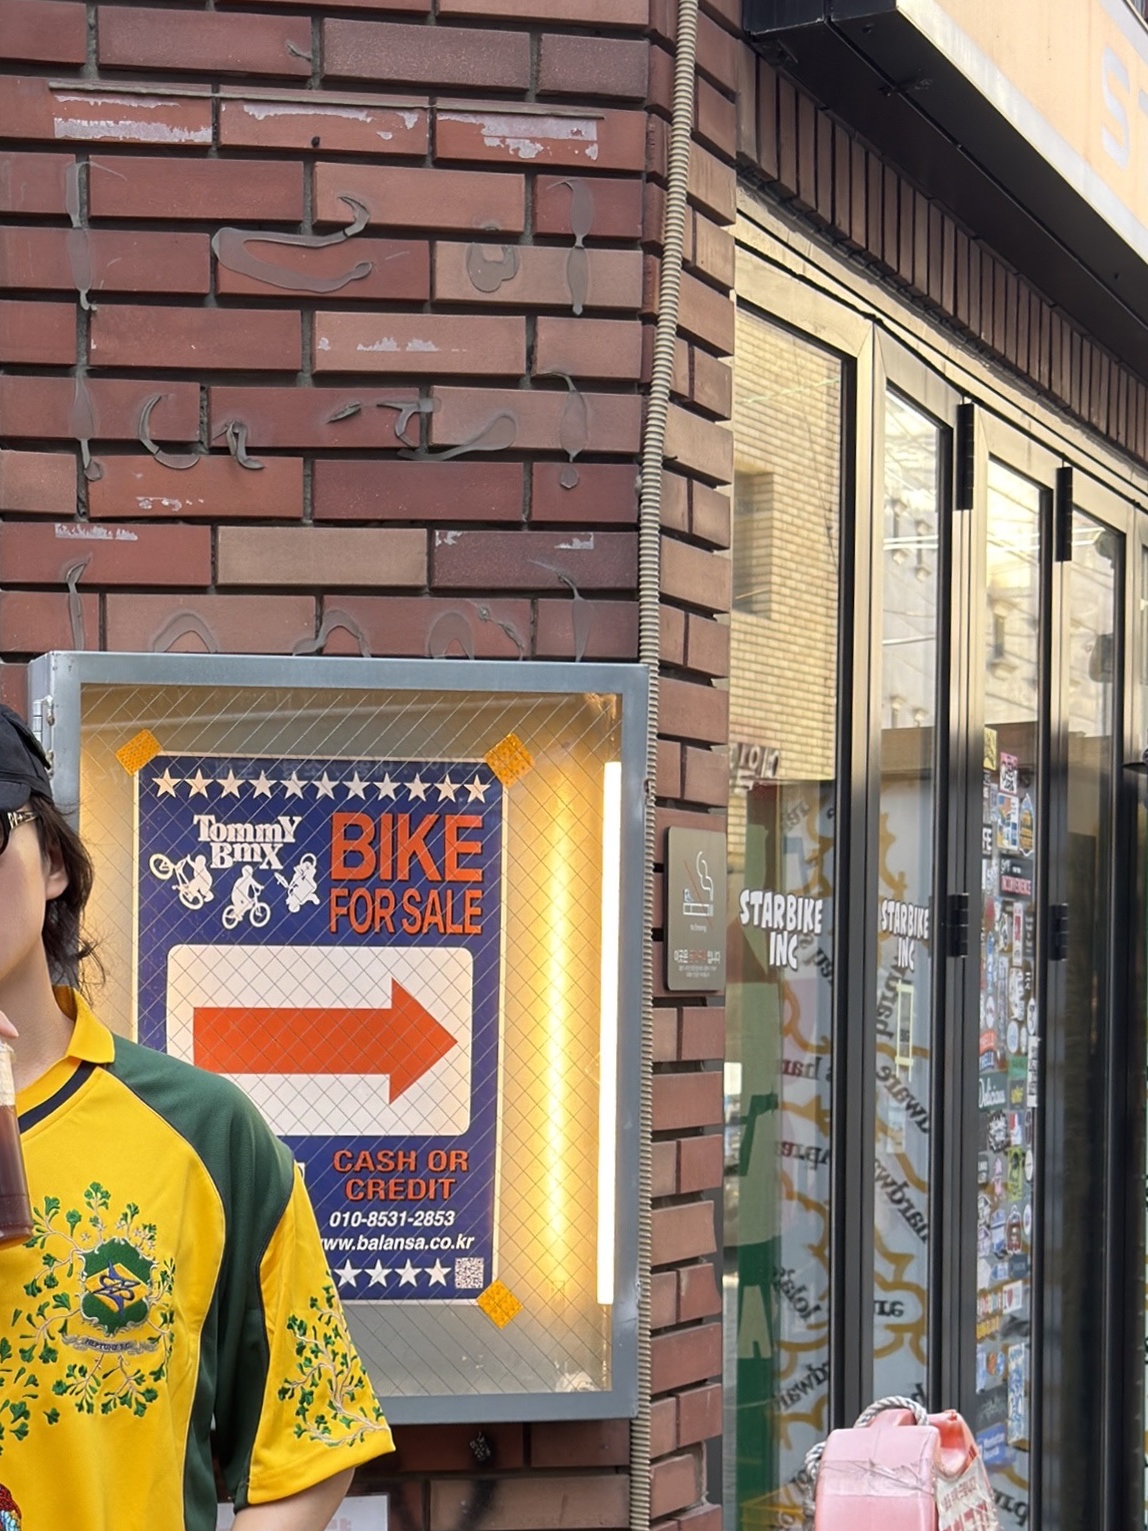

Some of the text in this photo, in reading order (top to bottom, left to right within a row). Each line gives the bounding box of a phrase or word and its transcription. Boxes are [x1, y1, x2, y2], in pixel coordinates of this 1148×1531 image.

[330, 811, 483, 883] BIKE
[329, 887, 483, 935] FOR SALE
[739, 888, 823, 935] STARBIKE
[881, 899, 930, 940] STARBIKE
[769, 930, 798, 971] INC
[897, 936, 915, 971] INC
[333, 1150, 468, 1172] CASH OR
[345, 1178, 456, 1200] CREDIT
[329, 1211, 455, 1228] 010-8531-2853
